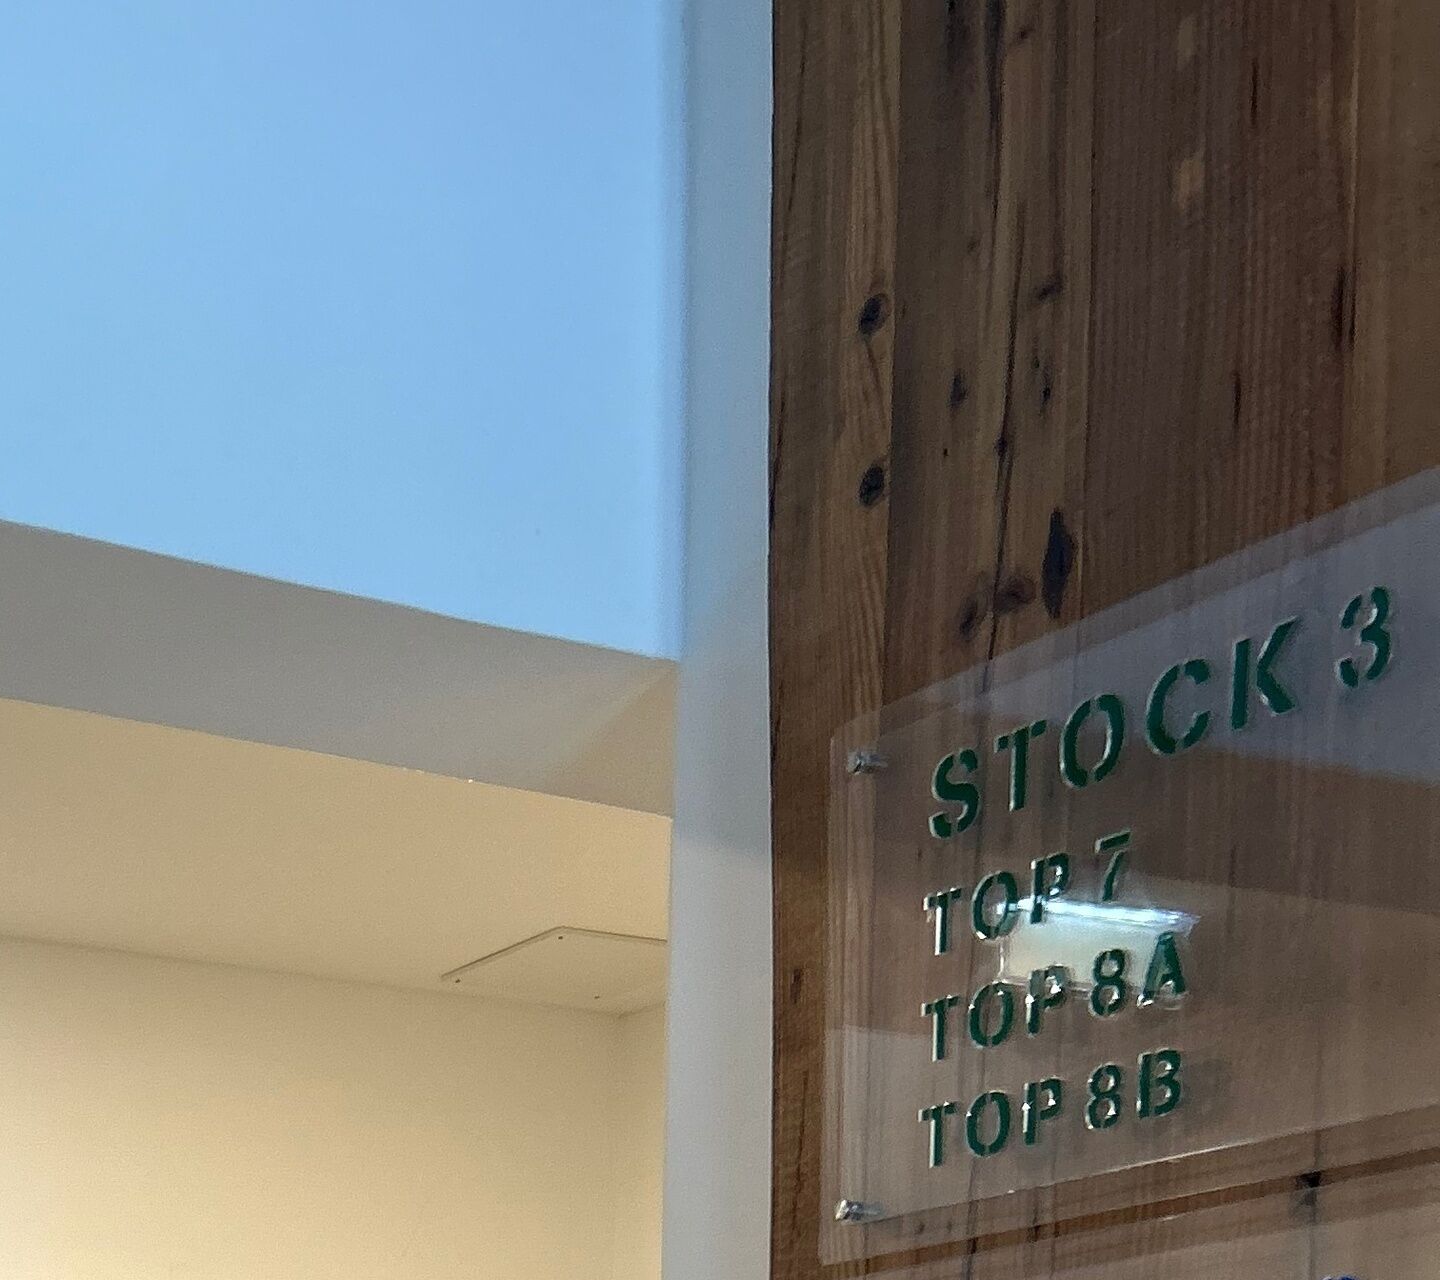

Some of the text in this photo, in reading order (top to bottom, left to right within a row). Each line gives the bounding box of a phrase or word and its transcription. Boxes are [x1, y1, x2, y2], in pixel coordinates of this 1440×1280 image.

[928, 586, 1392, 839] STOCK 3
[923, 829, 1131, 956] TOP 7
[921, 931, 1189, 1062] TOP 8A
[918, 1048, 1182, 1167] TOP 8B
